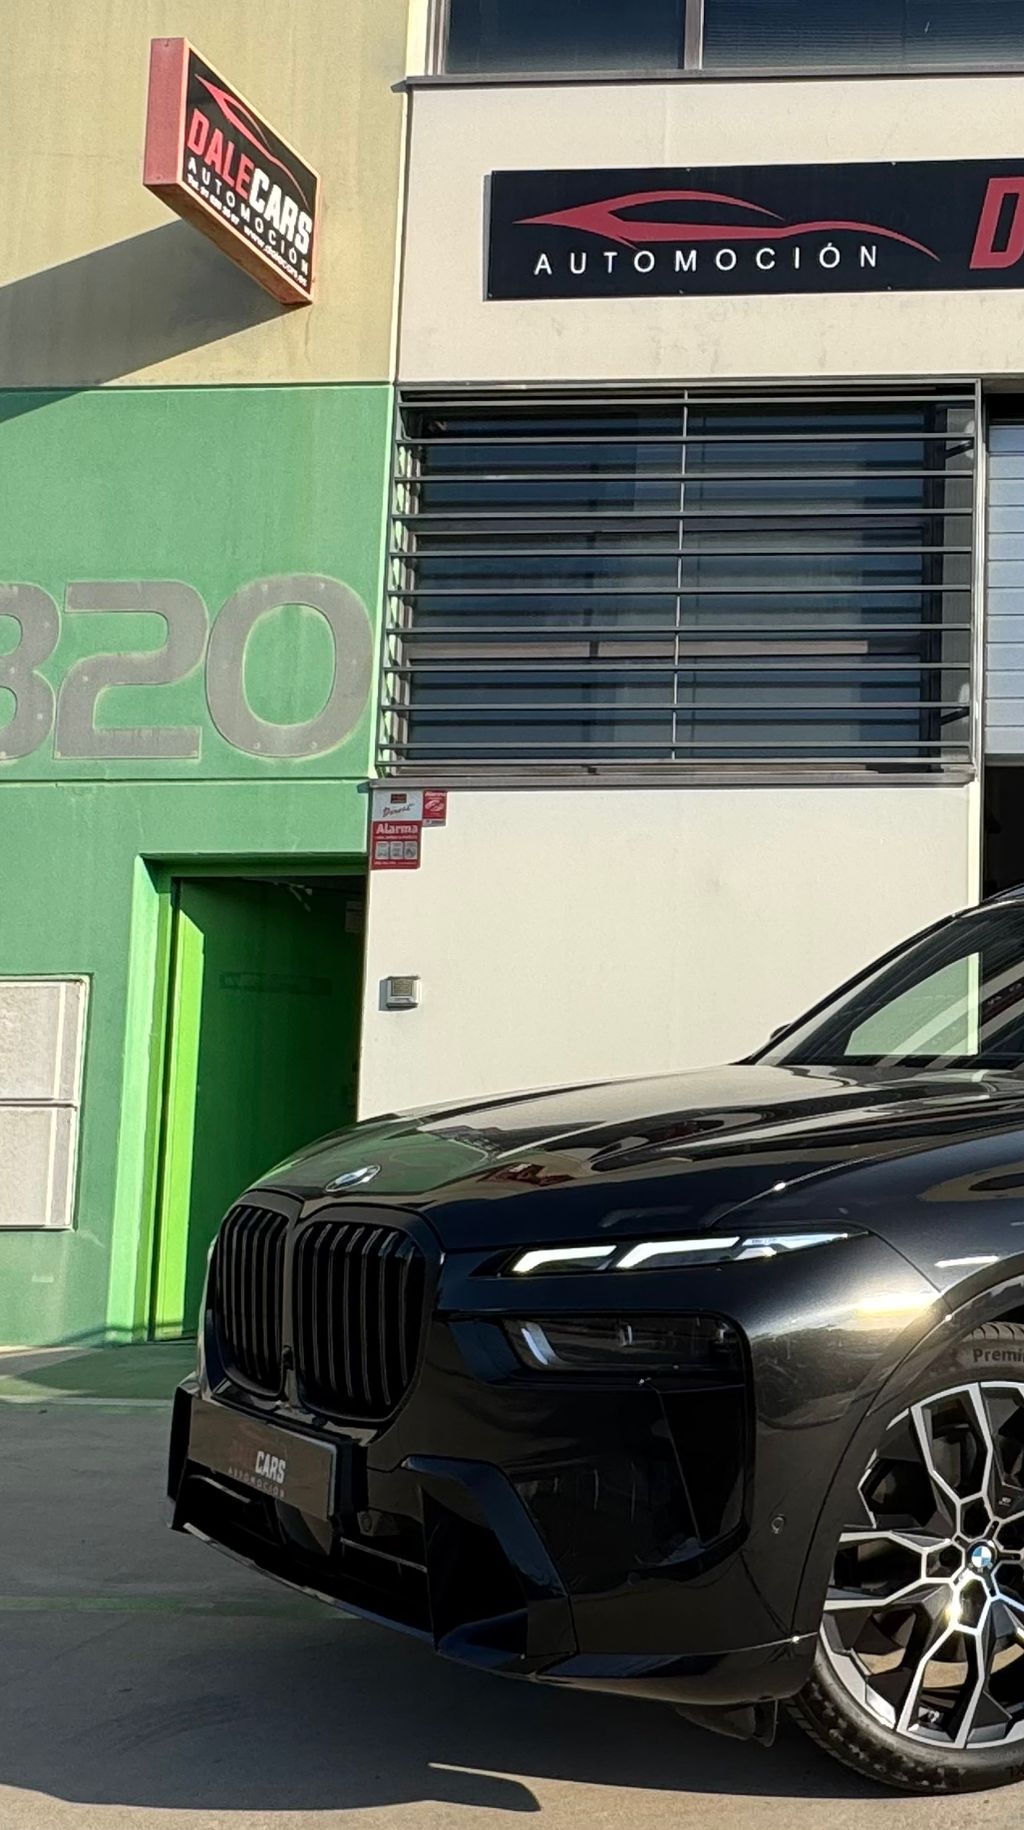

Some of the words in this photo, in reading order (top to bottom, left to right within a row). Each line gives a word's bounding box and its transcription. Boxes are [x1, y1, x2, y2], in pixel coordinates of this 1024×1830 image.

[187, 108, 313, 254] DALECARS
[187, 157, 309, 276] AUTOMOCIÓN
[533, 242, 878, 276] AUTOMOCIÓN
